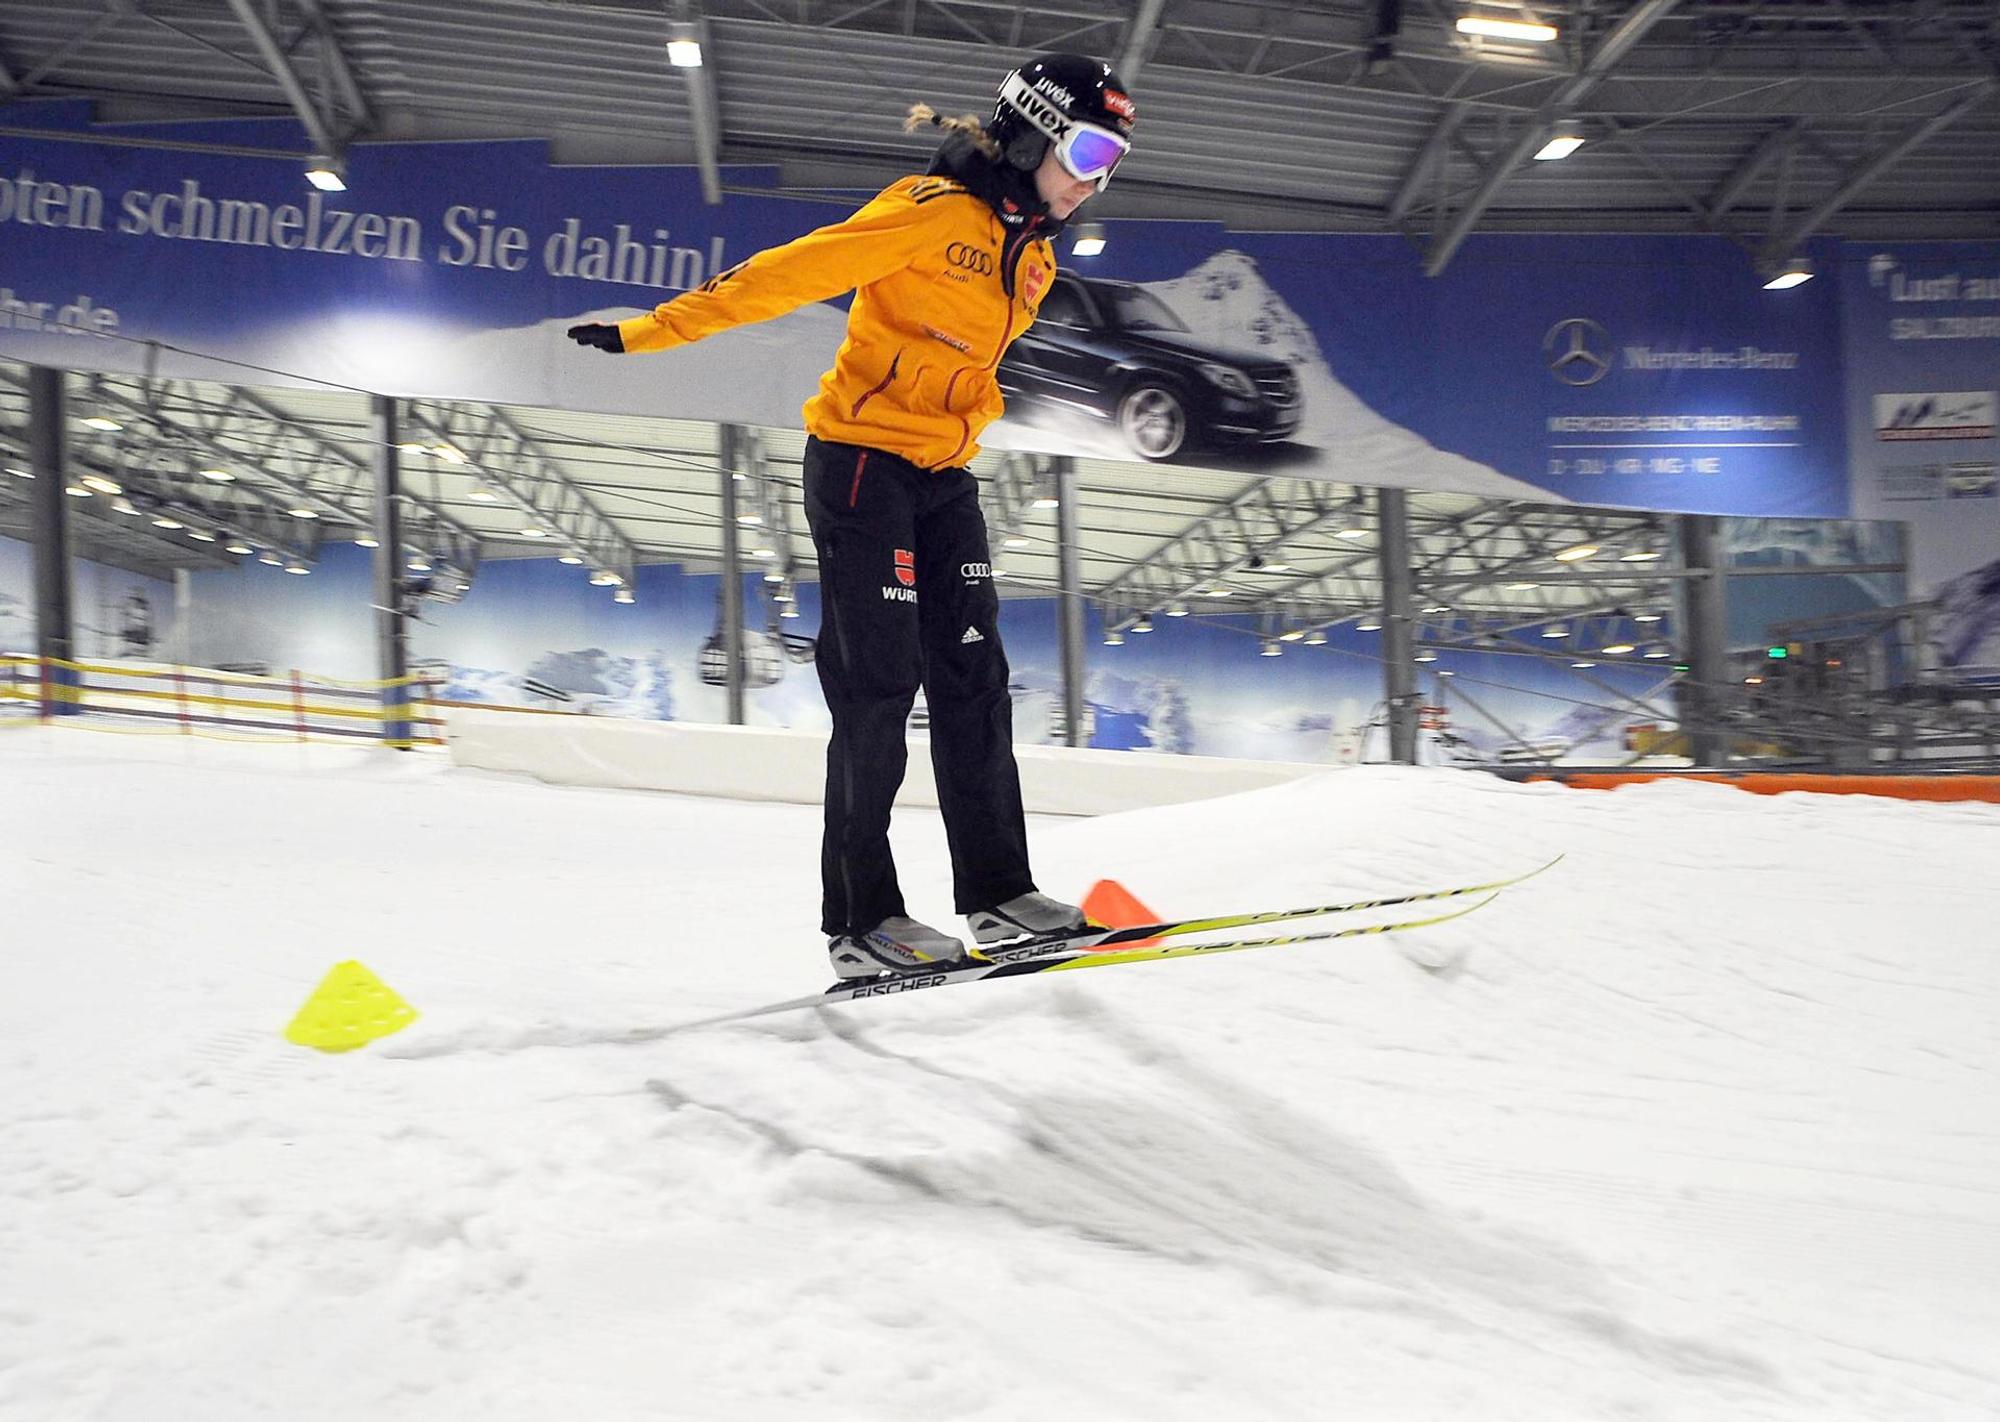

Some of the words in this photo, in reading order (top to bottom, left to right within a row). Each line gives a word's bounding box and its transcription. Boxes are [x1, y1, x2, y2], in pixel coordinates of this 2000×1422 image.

[1016, 87, 1072, 140] uvex
[1032, 77, 1076, 110] uvex
[117, 179, 421, 263] schmelzen
[437, 204, 529, 272] Sie
[852, 975, 947, 999] FISCHER
